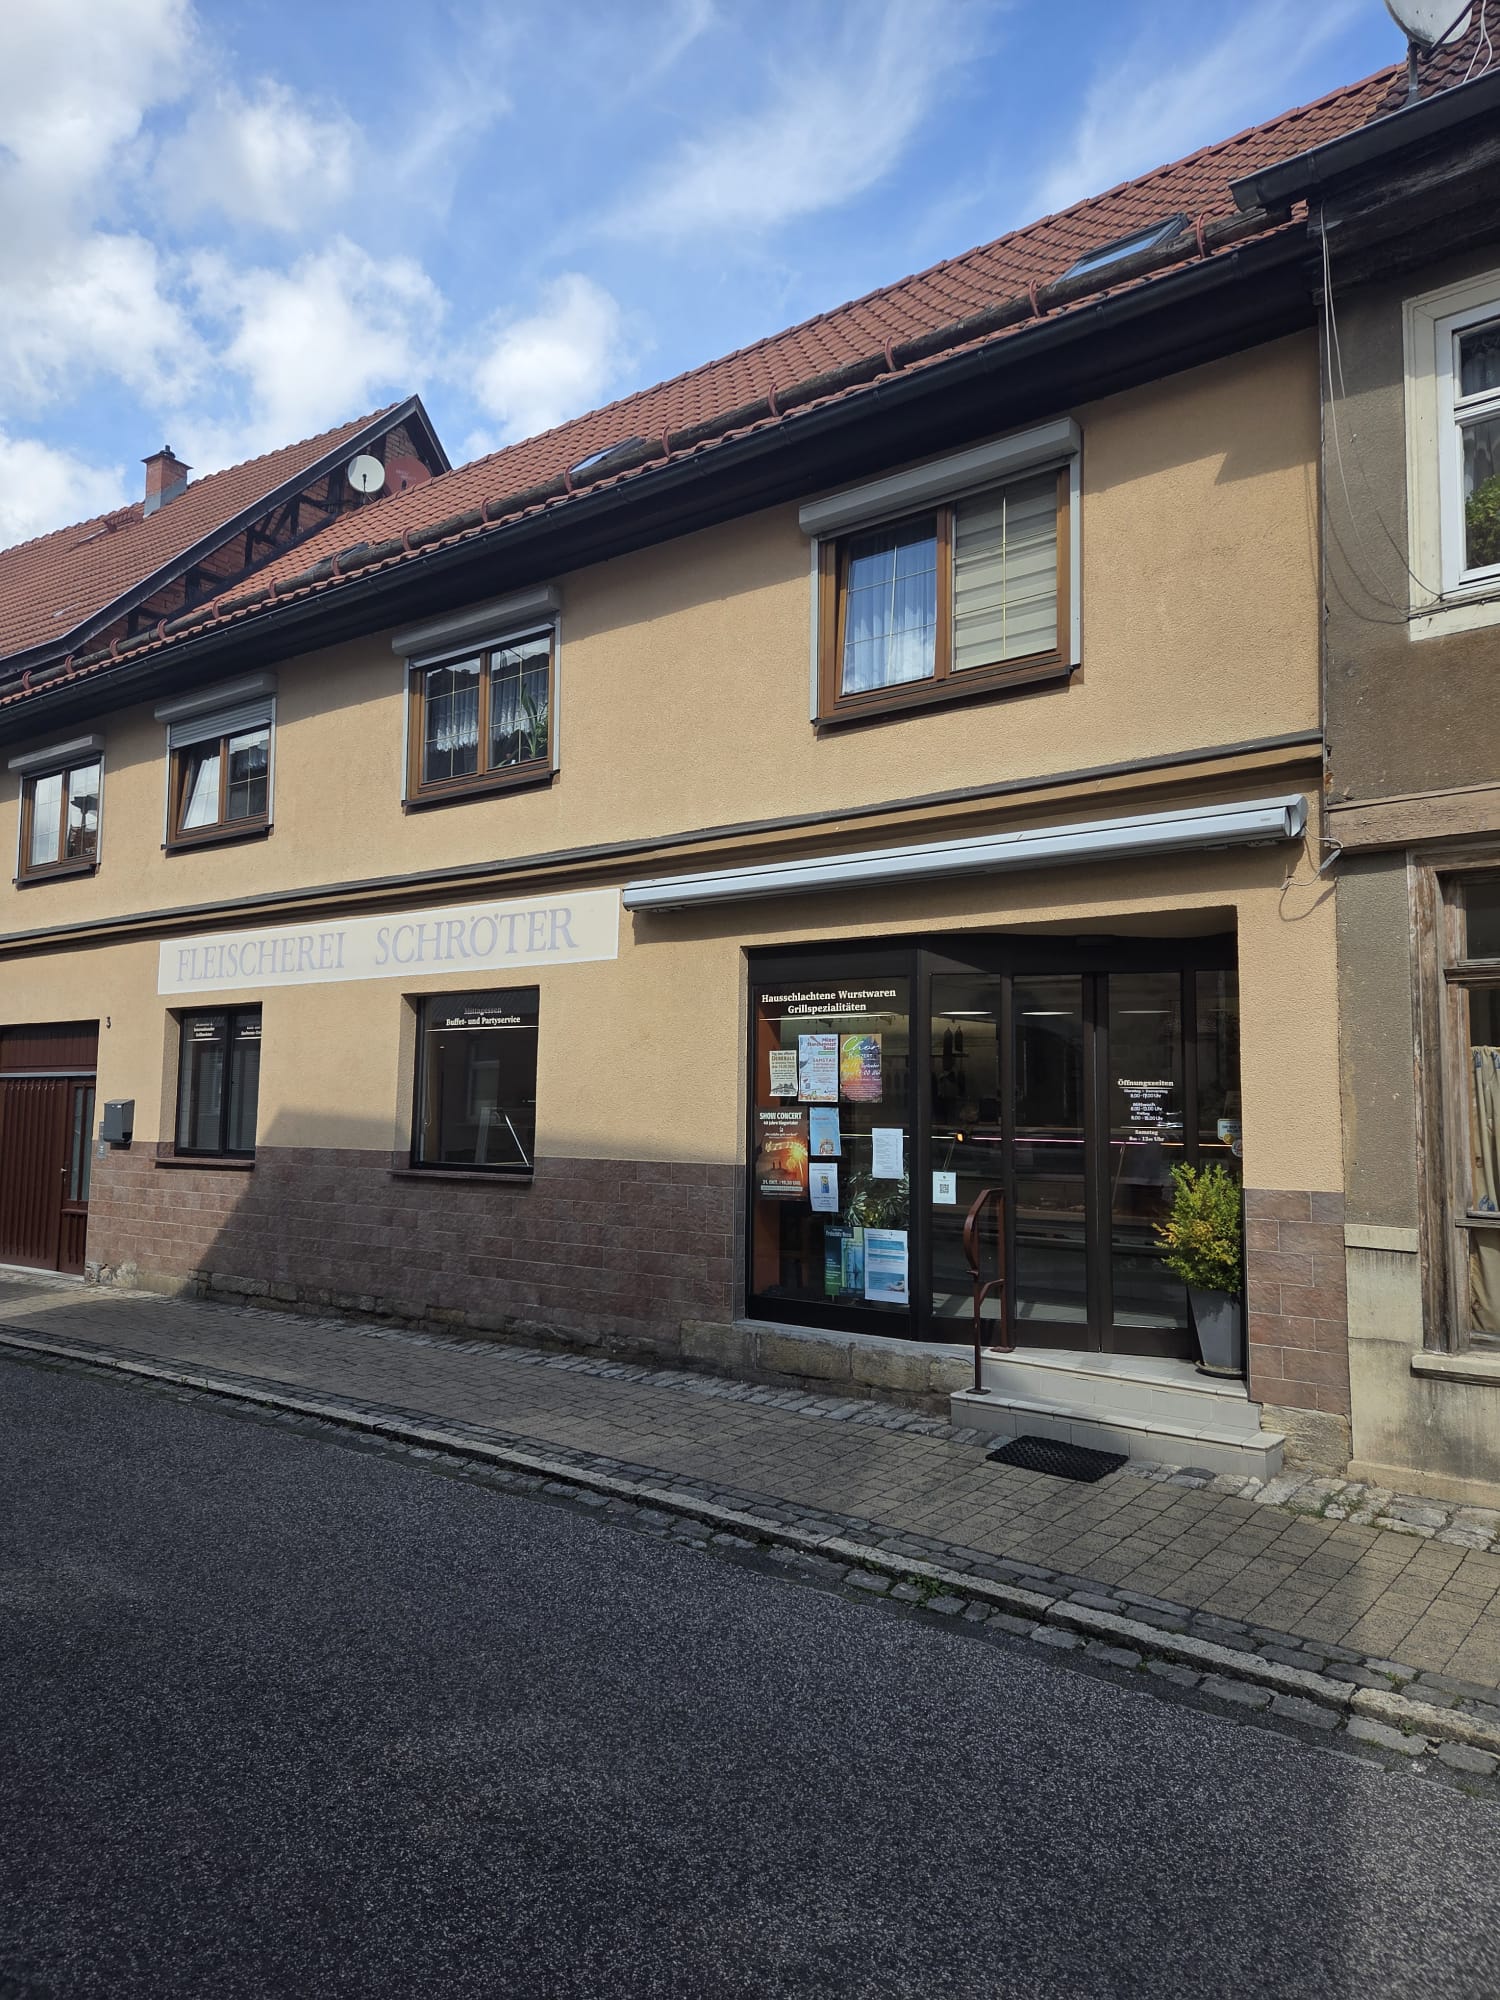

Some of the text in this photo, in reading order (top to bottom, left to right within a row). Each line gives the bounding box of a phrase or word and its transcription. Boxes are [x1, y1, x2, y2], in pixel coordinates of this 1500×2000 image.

[176, 907, 579, 982] FLEISCHEREI SCHRÖTER
[761, 989, 897, 1003] Hausschlachtene Wurstwaren
[787, 1003, 867, 1014] Grillspezialitäten
[106, 1016, 112, 1029] 3
[468, 1017, 480, 1025] und
[481, 1016, 521, 1026] Partyservice
[1117, 1078, 1174, 1087] Öffnungszeiten
[759, 1112, 803, 1120] SHOW CONCERT
